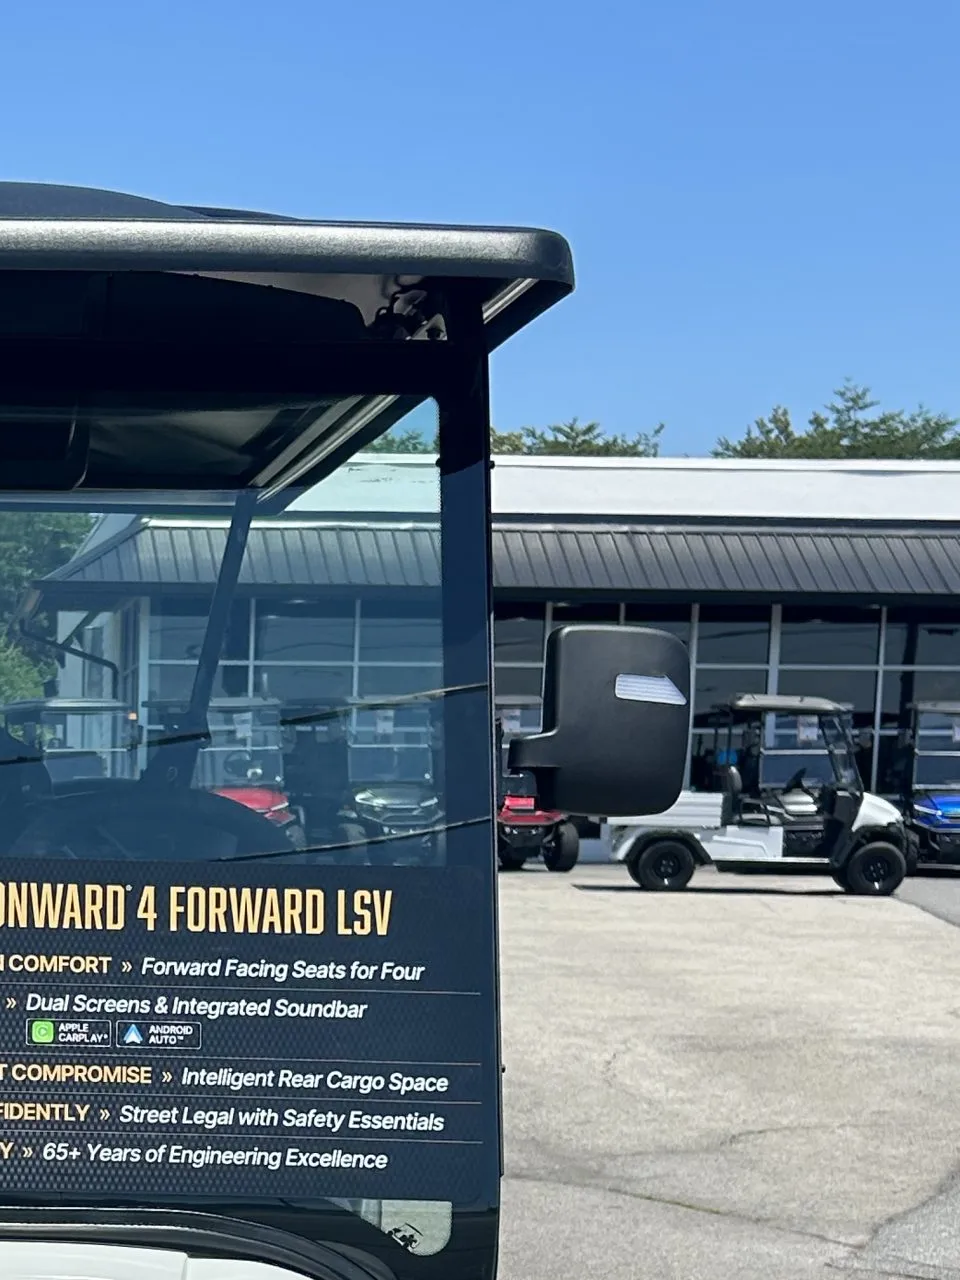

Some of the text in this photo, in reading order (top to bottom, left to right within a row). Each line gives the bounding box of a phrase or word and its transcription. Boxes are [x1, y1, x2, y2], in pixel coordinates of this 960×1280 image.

[137, 886, 157, 931] 4
[169, 887, 324, 935] FORWARD
[337, 890, 392, 935] LSV
[9, 955, 112, 973] COMFORT
[142, 958, 221, 977] Forward
[225, 960, 288, 981] Facing
[292, 961, 346, 980] Seats
[350, 962, 378, 980] for
[380, 963, 425, 981] Four
[26, 993, 69, 1012] Dual
[72, 995, 150, 1014] Screens
[154, 997, 169, 1014] &
[172, 997, 270, 1020] Integrated
[274, 999, 368, 1018] Soundbar
[58, 1023, 89, 1032] APPLE
[149, 1025, 193, 1035] ANDROID
[12, 1064, 152, 1083] COMPROMISE
[182, 1068, 274, 1090] Intelligent
[278, 1071, 323, 1088] Rear
[326, 1071, 385, 1093] Cargo
[388, 1073, 448, 1094] Space
[120, 1105, 178, 1124] Street
[182, 1107, 234, 1128] Legal
[238, 1108, 278, 1126] with
[282, 1109, 345, 1131] Safety
[348, 1110, 444, 1131] Essentials
[43, 1143, 81, 1161] 65+
[87, 1144, 141, 1162] Years
[145, 1146, 166, 1162] of
[169, 1146, 282, 1169] Engineering
[285, 1149, 388, 1168] Excellence
